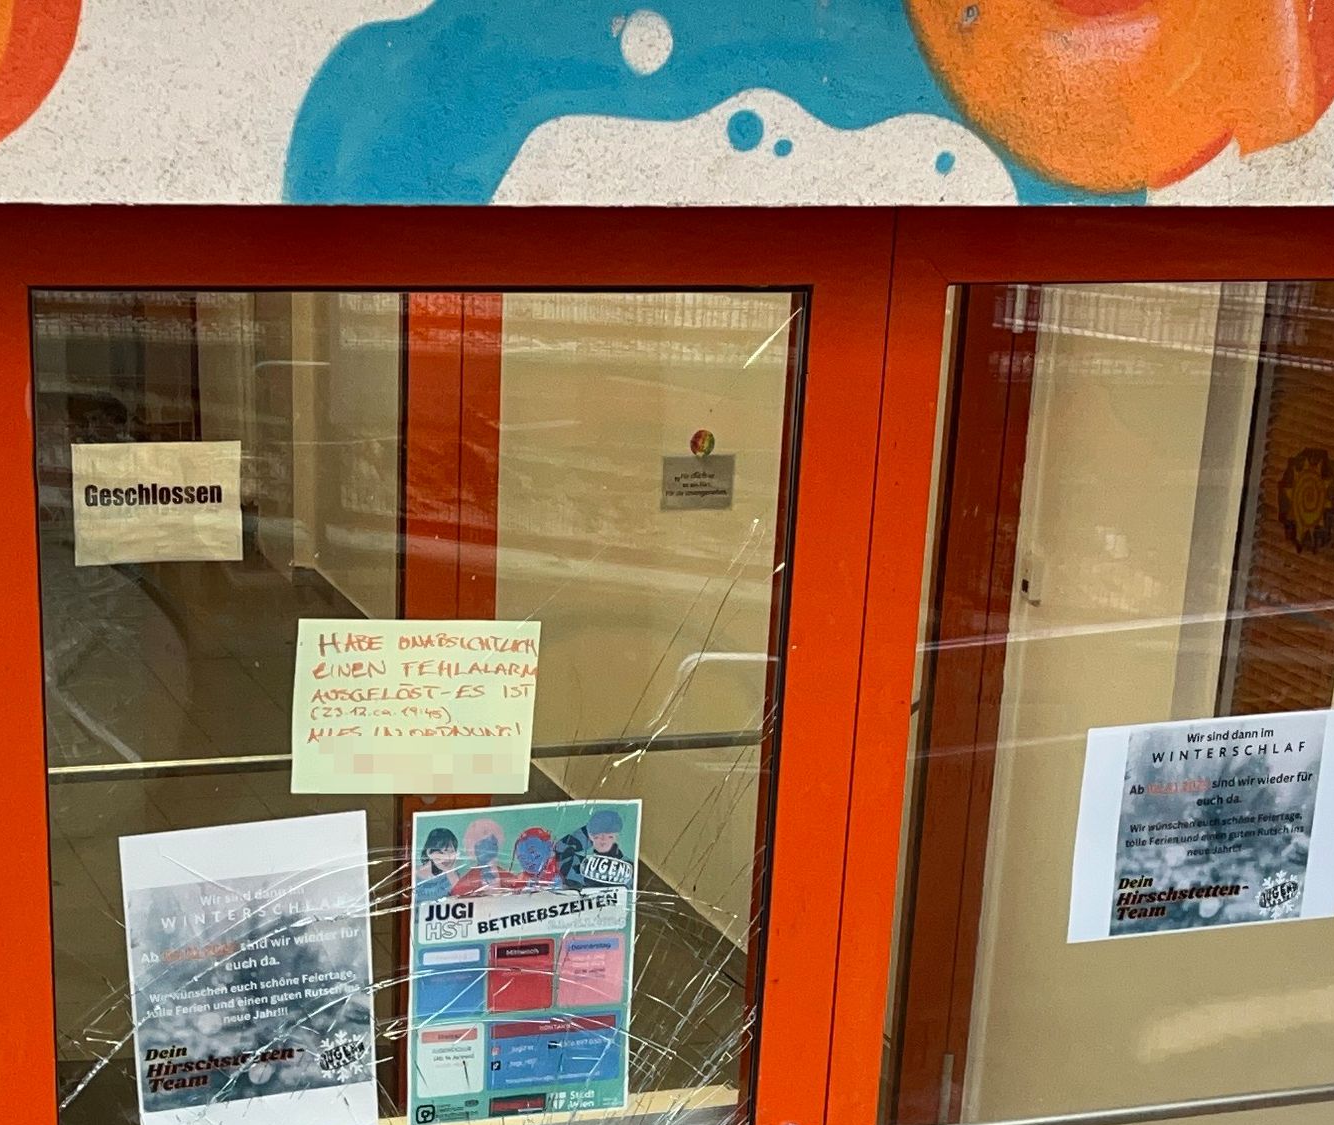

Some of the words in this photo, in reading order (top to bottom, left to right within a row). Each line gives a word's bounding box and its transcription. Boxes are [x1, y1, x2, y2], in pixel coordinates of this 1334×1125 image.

[84, 483, 223, 507] Geschlossen
[318, 632, 384, 657] HABE
[312, 660, 386, 680] EINEN
[401, 660, 539, 678] FEHLALARM
[503, 683, 534, 698] IST
[1187, 733, 1205, 744] Wir
[1206, 730, 1230, 742] sind
[1231, 729, 1258, 740] dann
[1260, 728, 1274, 738] im
[1152, 741, 1307, 764] WINTERSCHLAF
[1129, 784, 1145, 796] Ab
[1211, 777, 1236, 789] sind
[1237, 776, 1256, 787] wir
[1257, 773, 1295, 785] wieder
[1296, 771, 1313, 783] für
[1196, 794, 1224, 807] euch
[1225, 794, 1242, 805] da.
[1129, 824, 1147, 834] Wir
[1147, 819, 1196, 832] wünschen
[1197, 818, 1220, 828] euch
[1149, 835, 1179, 847] Ferien
[1180, 833, 1200, 843] und
[1228, 829, 1256, 841] guten
[585, 856, 631, 877] JUGEND
[1119, 875, 1154, 890] Dein
[1116, 882, 1249, 907] Hirschstetten-
[425, 902, 474, 922] JUGI
[477, 892, 618, 934] BETRIEBSZEITEN
[1117, 905, 1166, 921] Team
[426, 920, 473, 940] HST
[141, 952, 160, 964] Ab
[270, 937, 291, 948] wir
[340, 929, 360, 942] für
[225, 957, 257, 972] euch
[260, 955, 280, 967] da.
[229, 980, 258, 993] euch
[260, 976, 300, 989] schöne
[175, 1003, 211, 1016] Ferien
[213, 999, 235, 1011] und
[236, 996, 268, 1007] einen
[269, 992, 302, 1005] guten
[223, 1012, 252, 1025] neue
[145, 1044, 188, 1062] Dein
[146, 1046, 306, 1079] Hirschsteten-
[148, 1072, 209, 1093] Team
